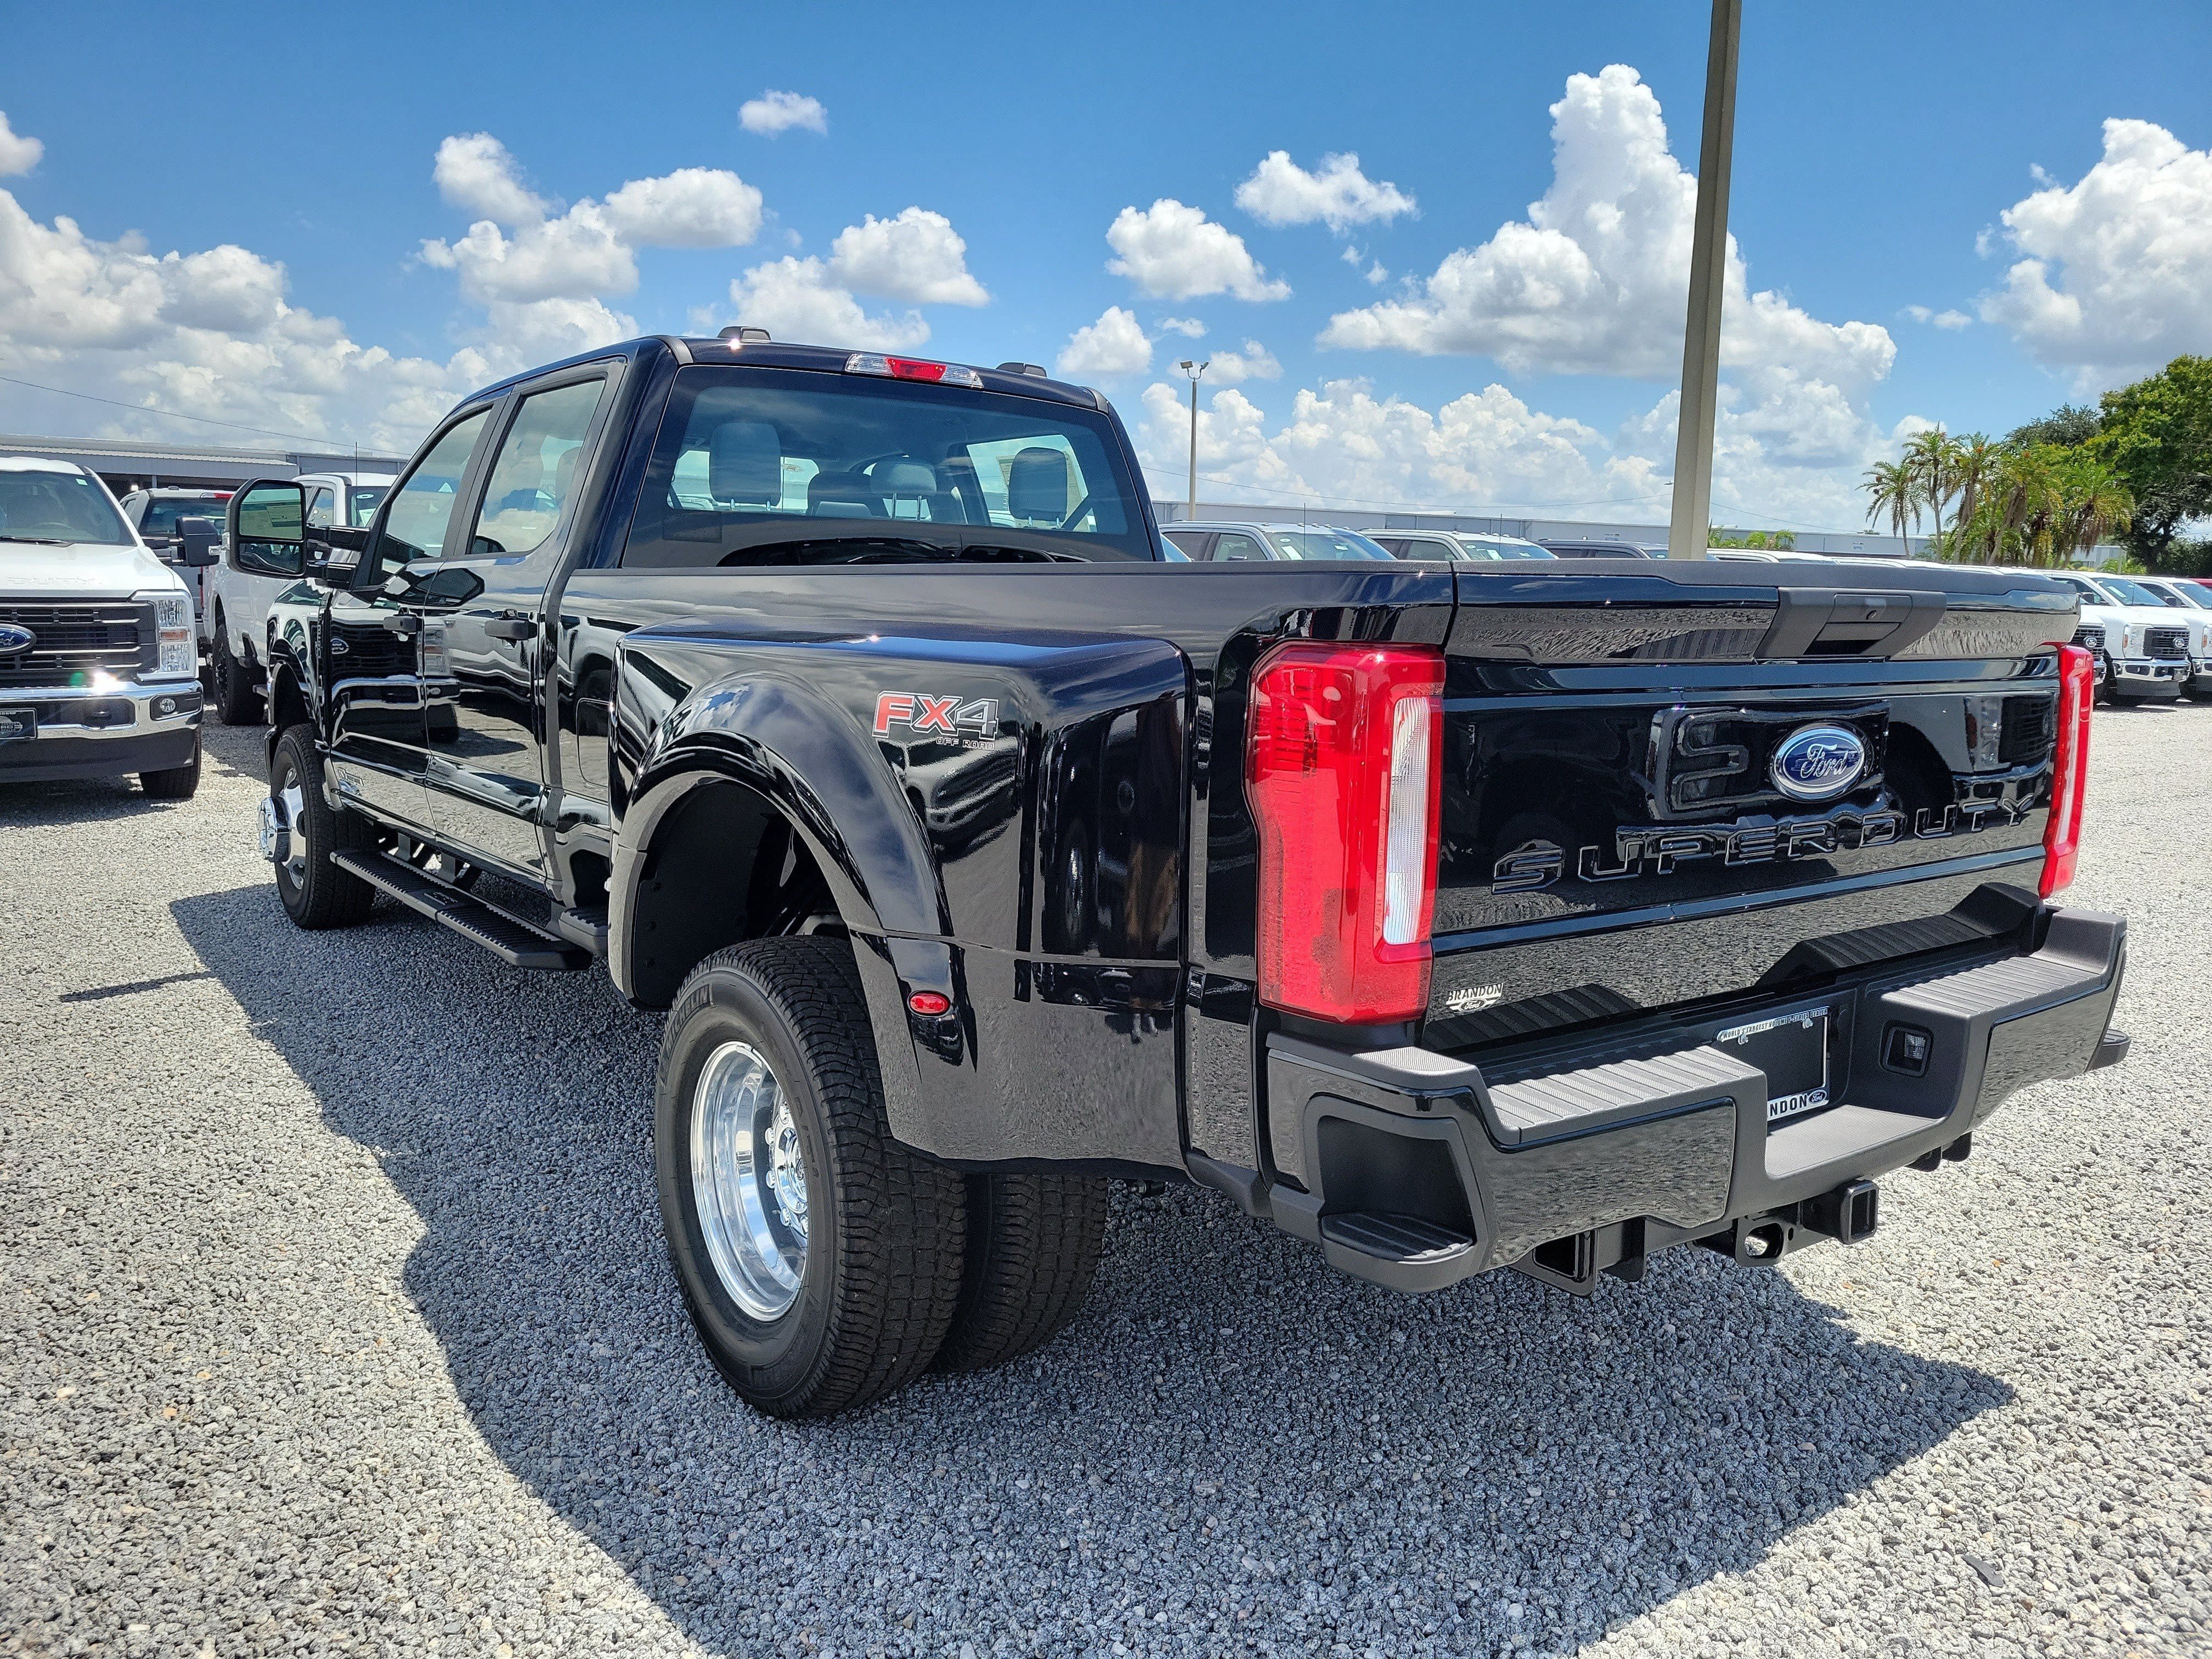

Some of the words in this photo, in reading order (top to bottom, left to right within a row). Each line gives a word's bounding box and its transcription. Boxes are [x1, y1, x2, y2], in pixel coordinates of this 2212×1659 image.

[0, 633, 14, 646] rd
[872, 691, 998, 740] FX4
[936, 737, 959, 747] OFF
[963, 740, 995, 750] ROAD
[1801, 743, 1848, 778] Ford
[1492, 820, 1837, 894] SUPER
[1859, 794, 2035, 849] DUTY
[1448, 984, 1502, 1001] BRANDON
[1464, 1000, 1480, 1009] Ford
[1723, 1029, 1745, 1039] WORLD'S
[1745, 1024, 1768, 1034] LARGEST
[1769, 1019, 1787, 1028] VOLUME
[1810, 1008, 1827, 1018] DEALER
[1770, 1093, 1807, 1116] NDON
[1812, 1094, 1824, 1102] Ford
